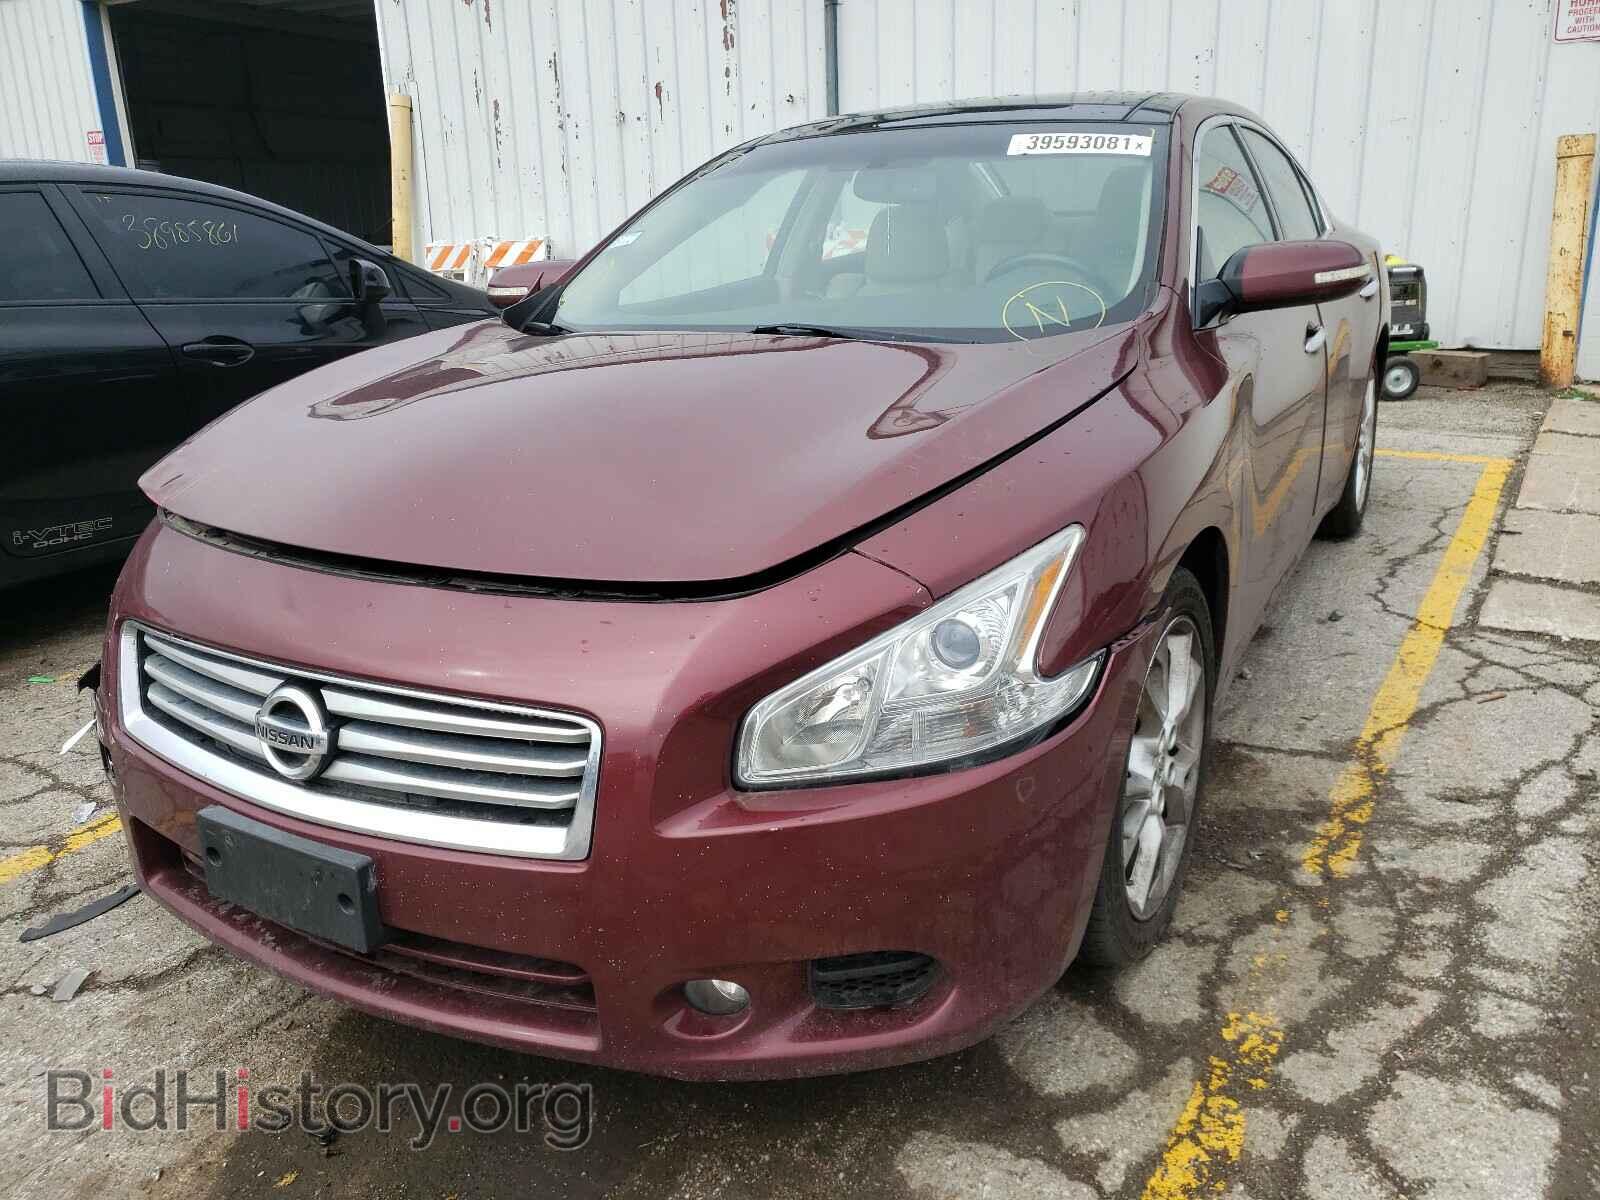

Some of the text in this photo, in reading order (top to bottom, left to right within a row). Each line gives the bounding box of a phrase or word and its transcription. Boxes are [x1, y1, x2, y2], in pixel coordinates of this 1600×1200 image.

[1575, 16, 1595, 24] WITH
[1026, 135, 1131, 150] 39593081
[12, 517, 113, 545] i-VTEC
[33, 532, 93, 548] DOHC
[256, 722, 315, 750] NISSAN
